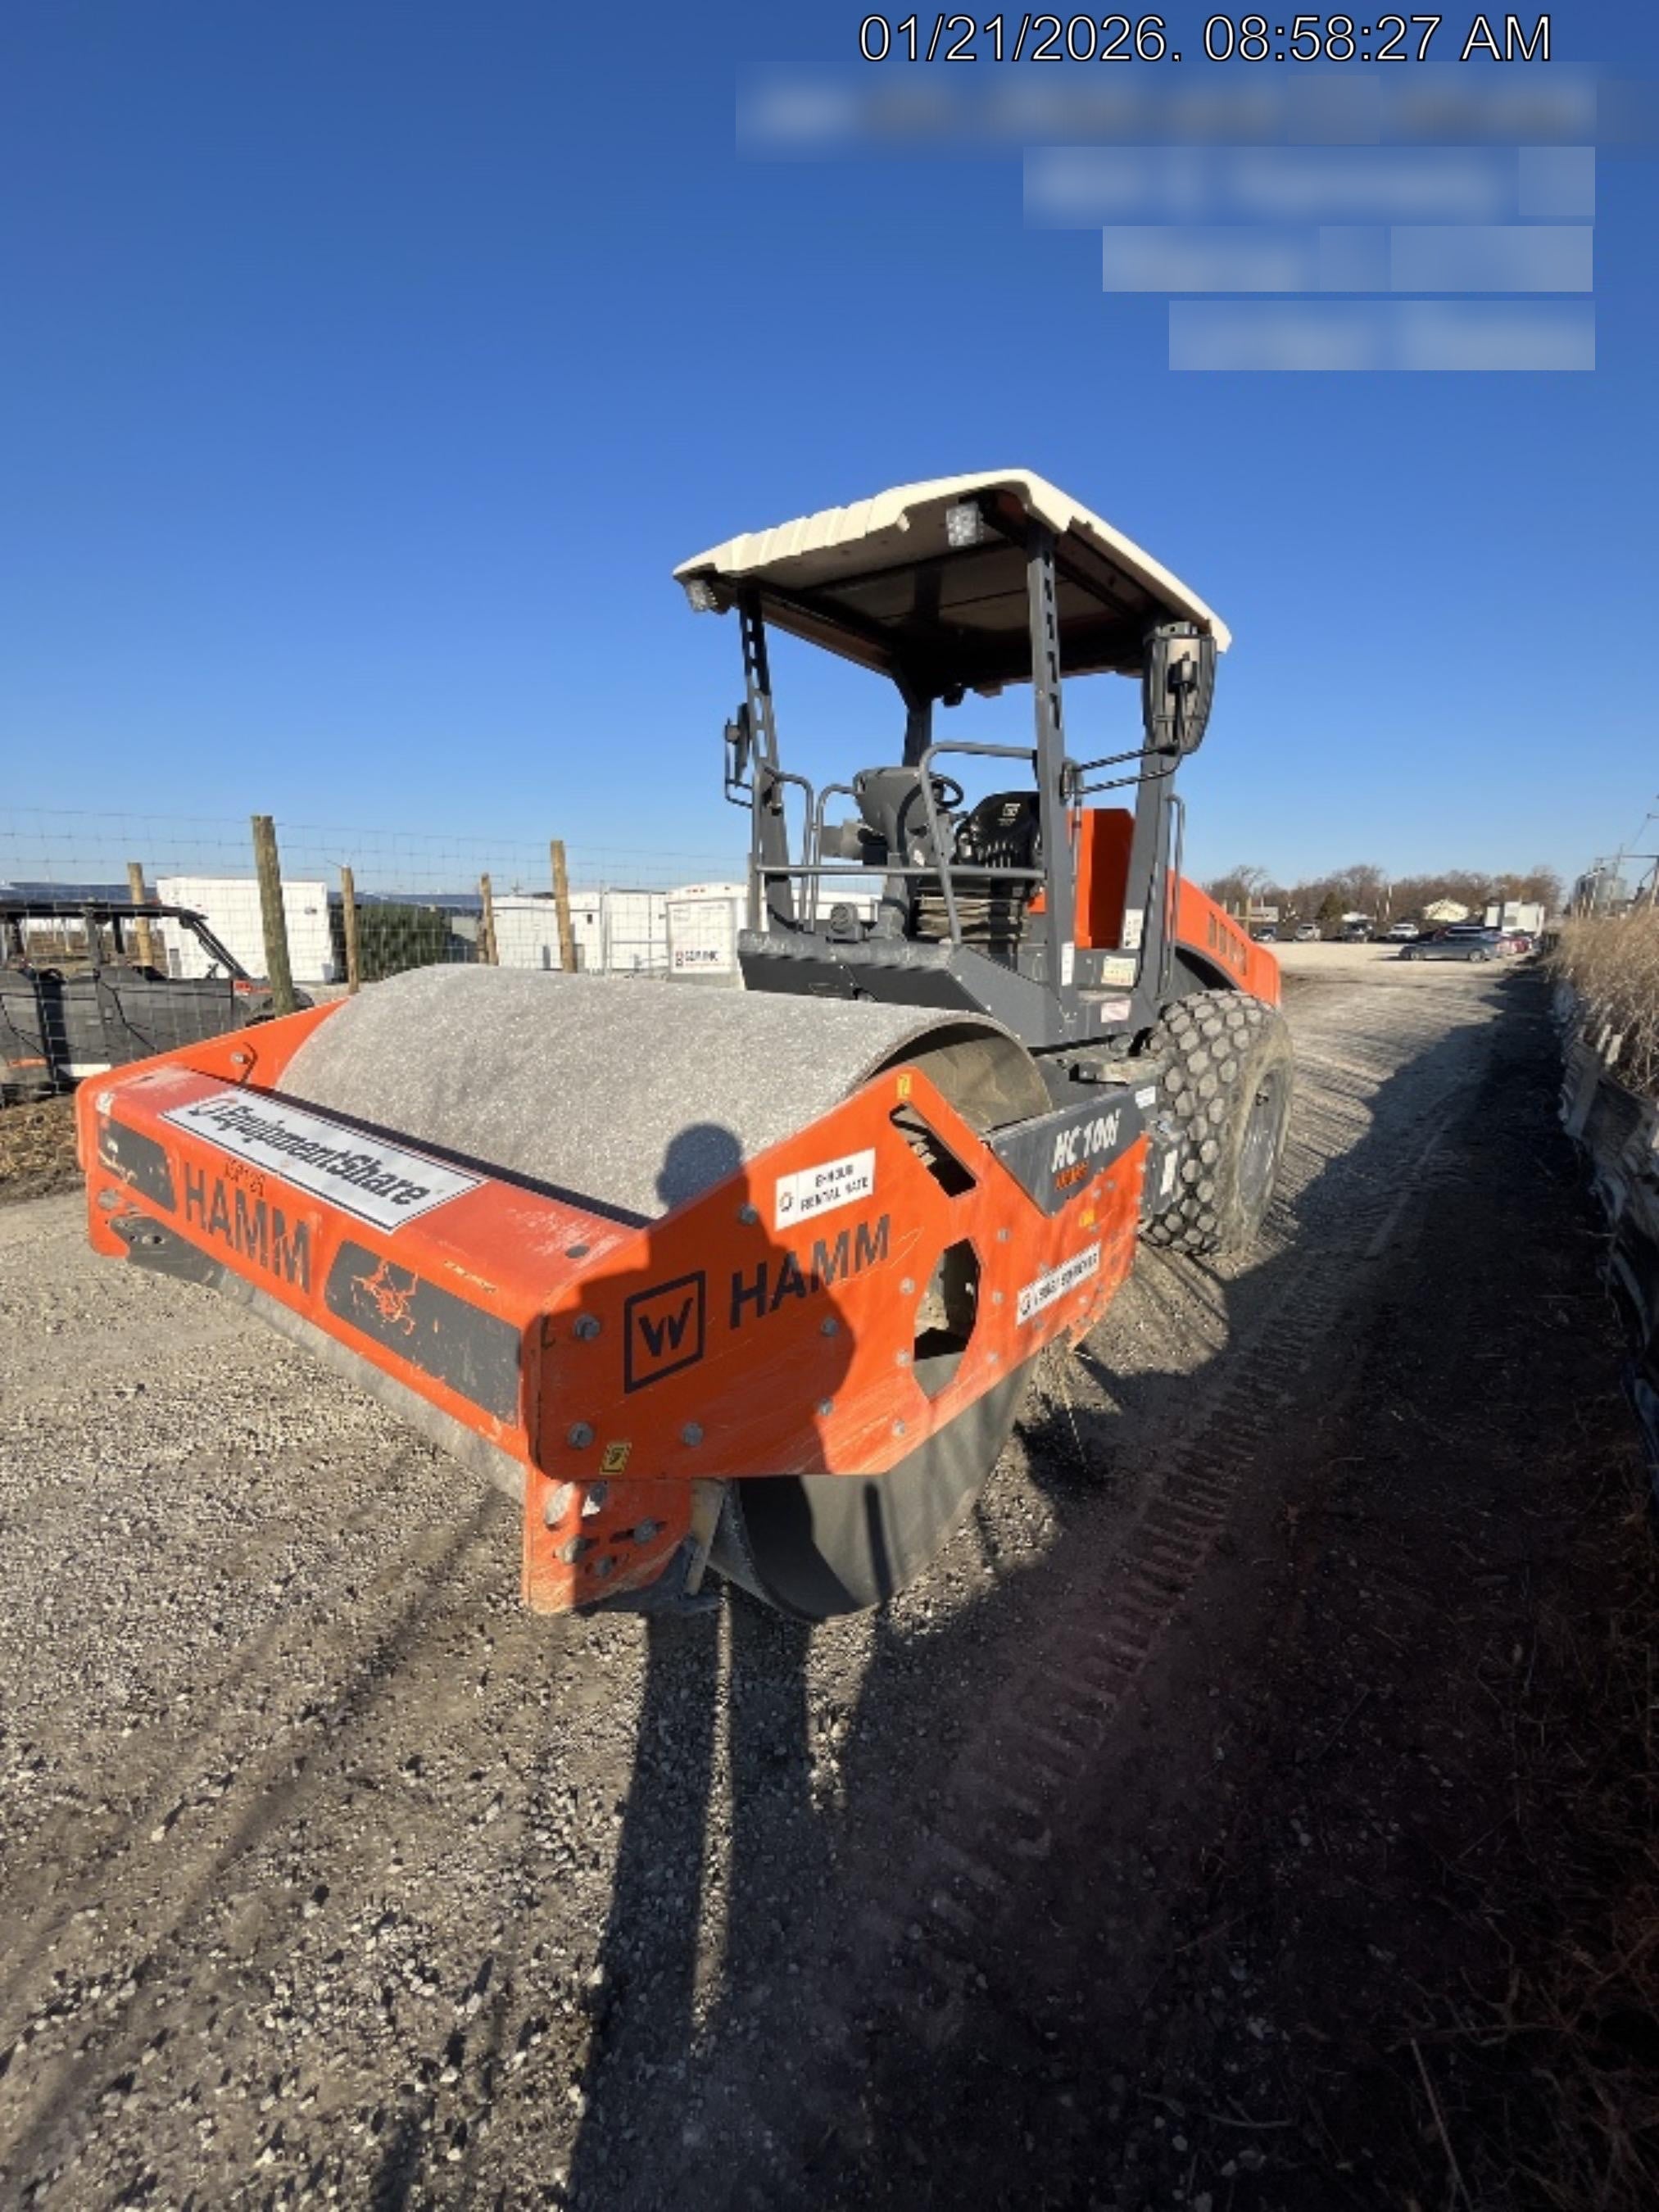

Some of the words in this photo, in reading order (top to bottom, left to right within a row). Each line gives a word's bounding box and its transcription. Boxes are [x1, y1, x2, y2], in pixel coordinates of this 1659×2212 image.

[211, 1105, 431, 1206] EquipmentShare
[185, 1161, 310, 1295] HAMM
[729, 1213, 891, 1330] HAMM
